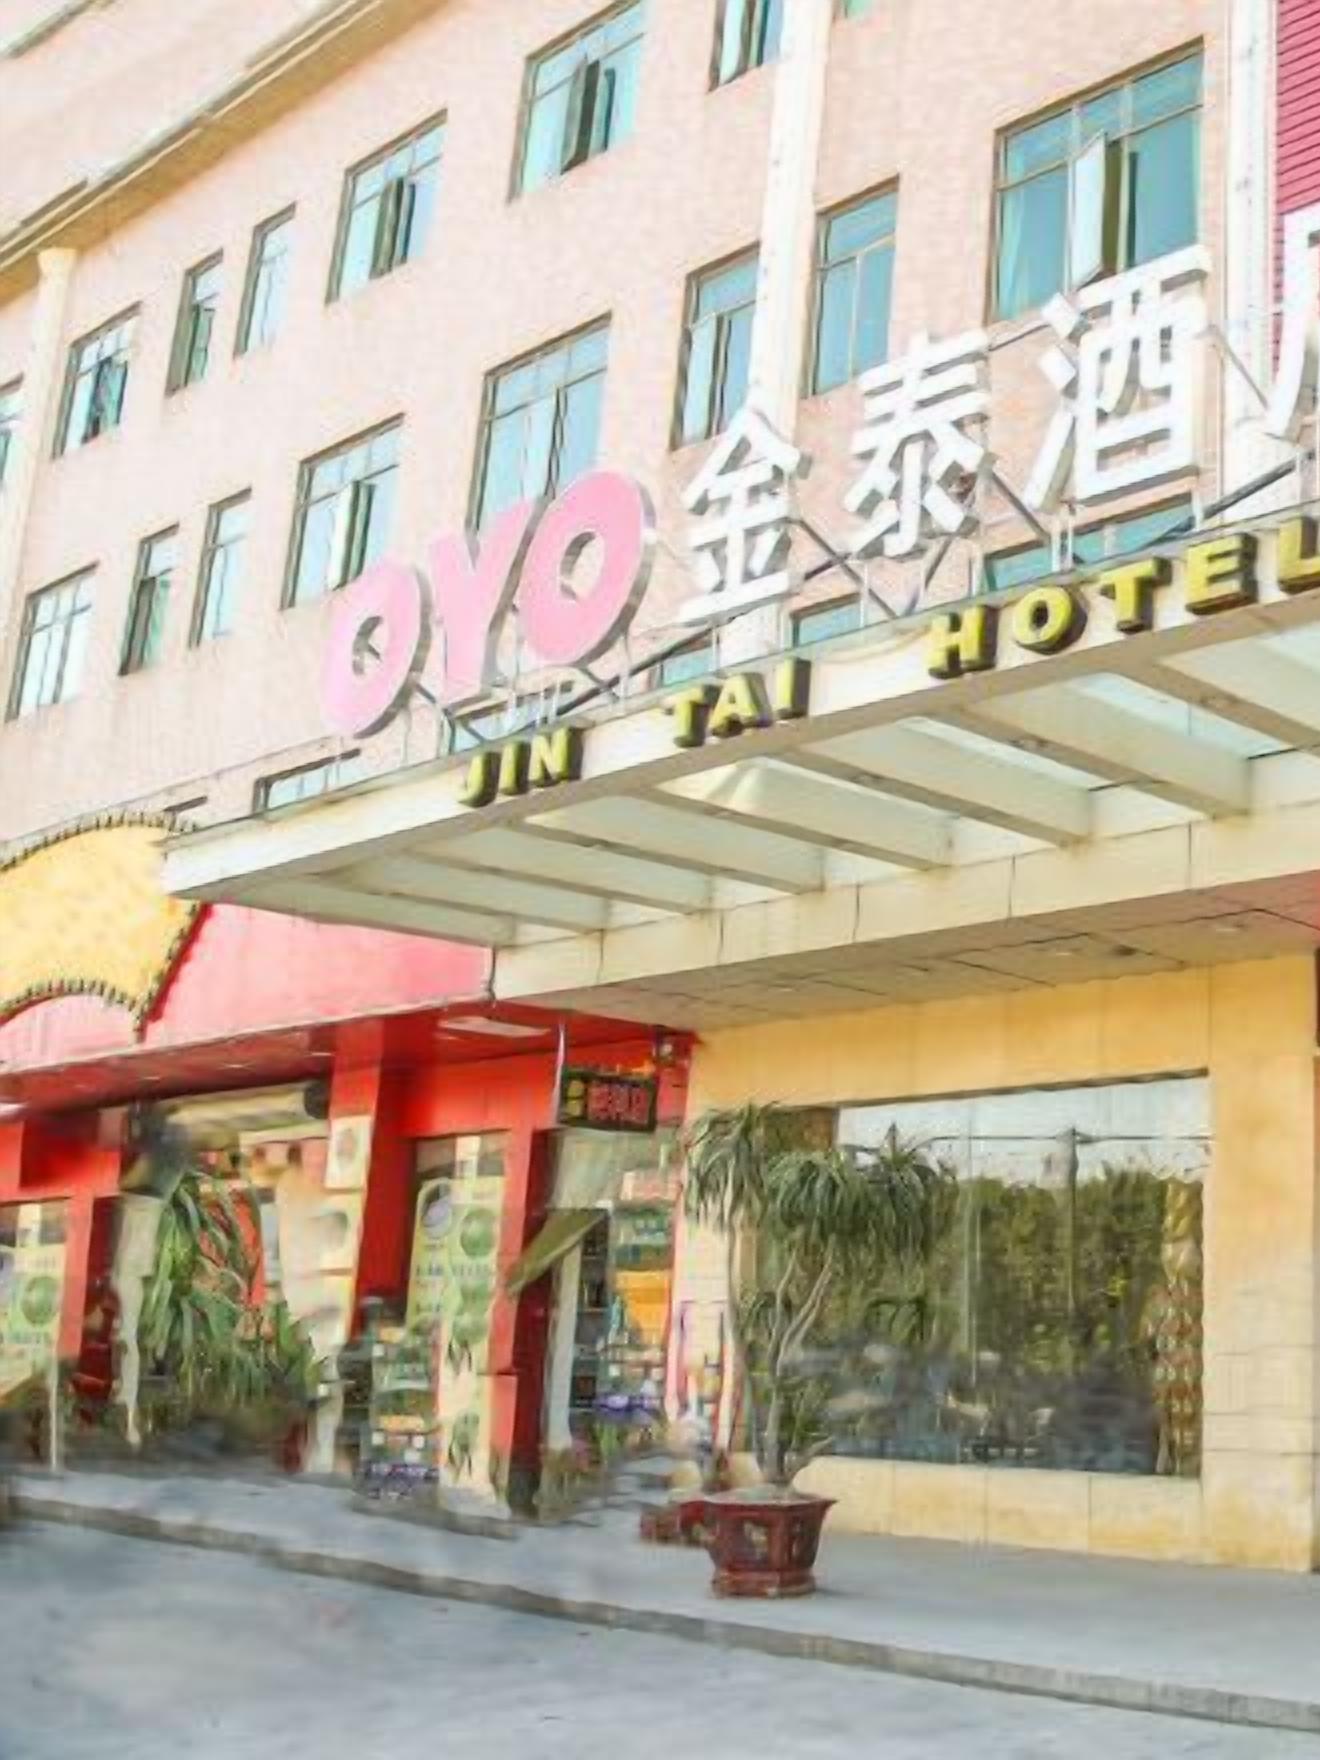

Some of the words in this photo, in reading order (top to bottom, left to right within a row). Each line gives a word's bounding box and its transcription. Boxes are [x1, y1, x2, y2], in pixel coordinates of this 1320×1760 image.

[319, 469, 655, 737] OYO
[457, 726, 583, 807] JIN
[664, 655, 811, 747] TAI
